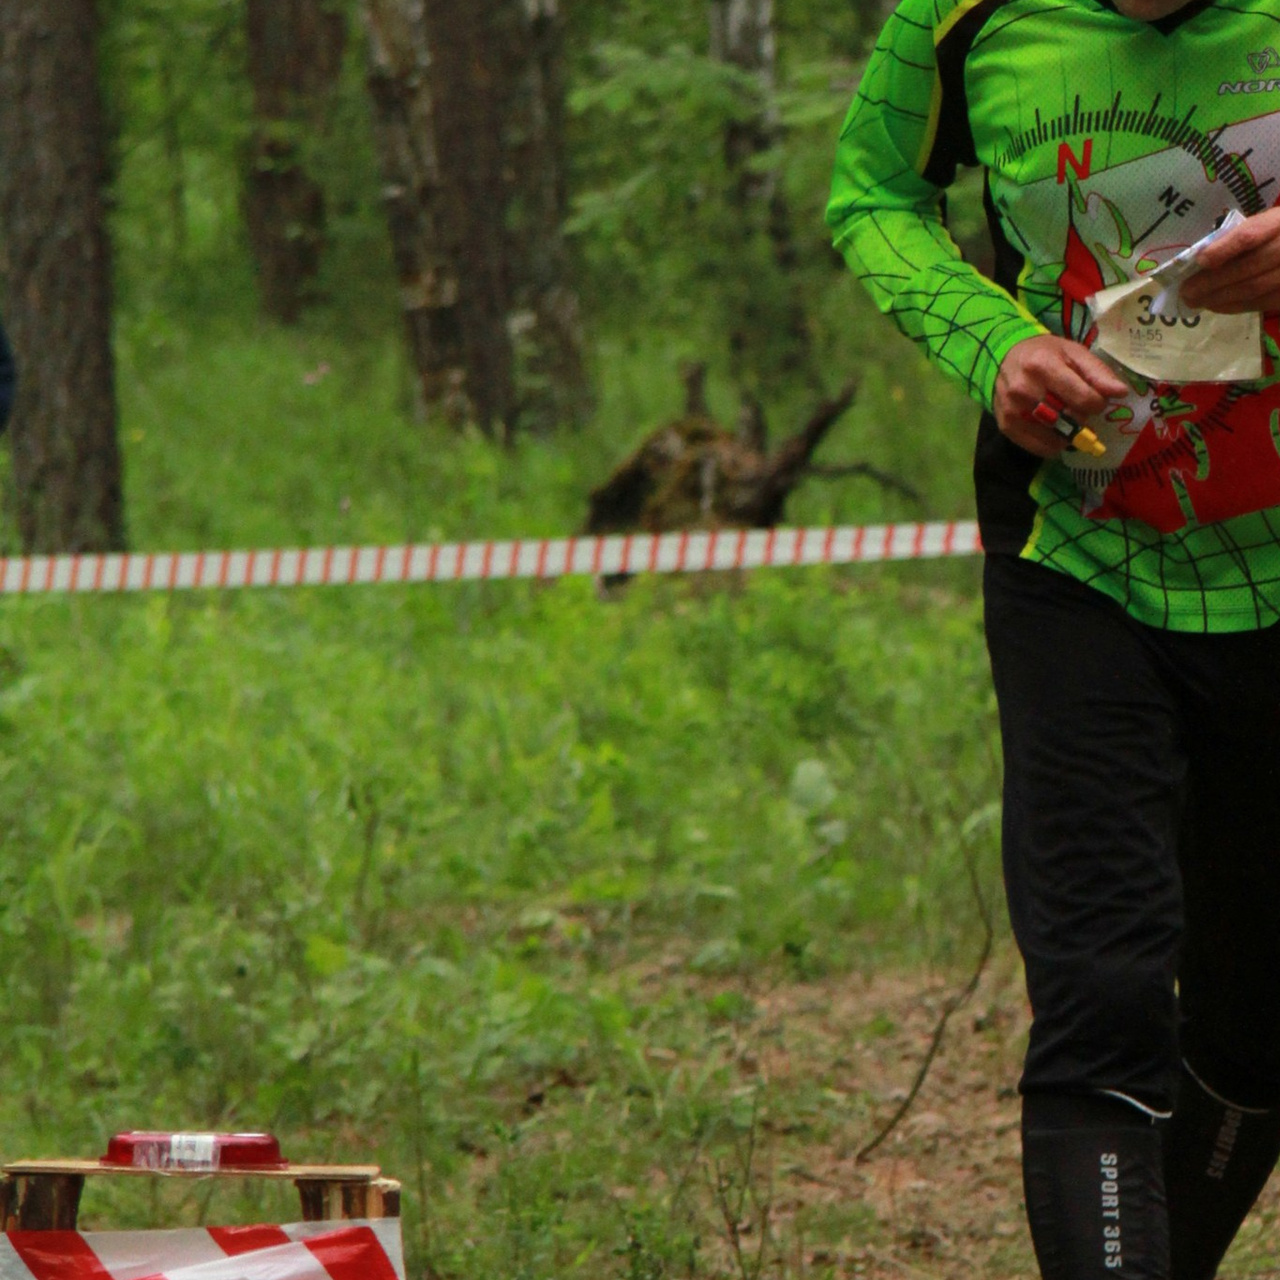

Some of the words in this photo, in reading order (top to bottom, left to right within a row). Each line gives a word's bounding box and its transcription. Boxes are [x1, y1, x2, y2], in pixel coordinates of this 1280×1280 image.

[1056, 138, 1093, 185] N
[1158, 185, 1195, 218] NE
[1101, 1153, 1119, 1219] SPORT
[1104, 1226, 1122, 1268] 365
